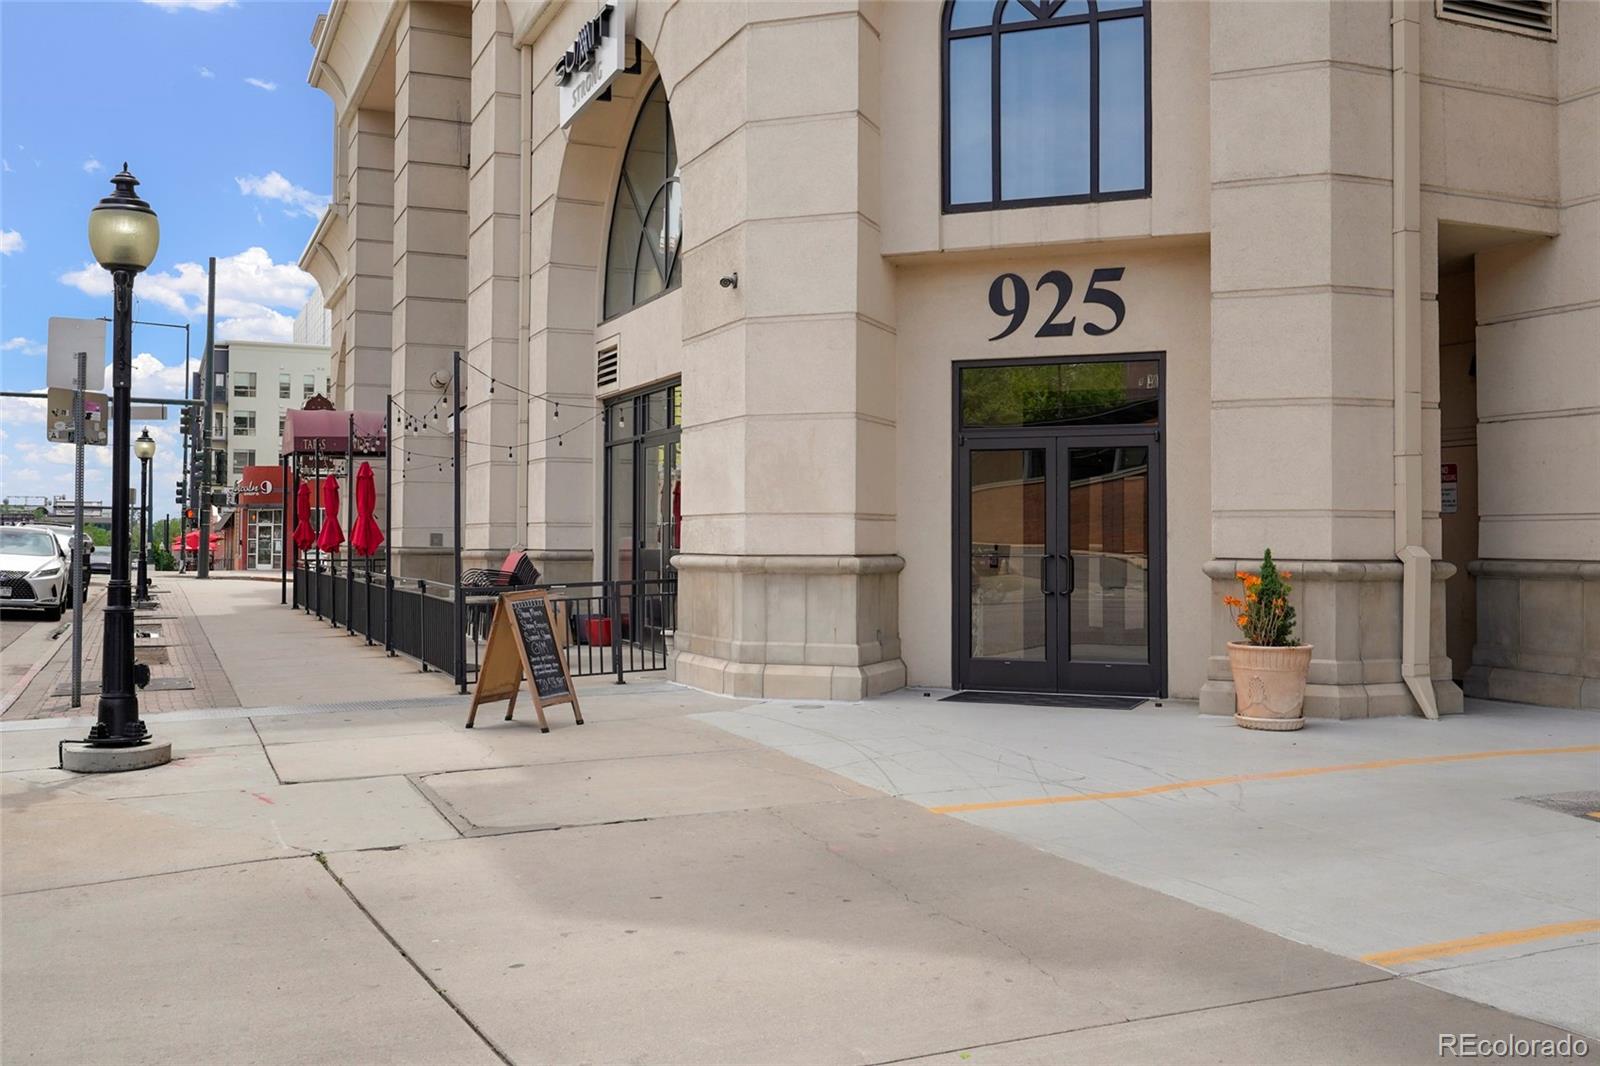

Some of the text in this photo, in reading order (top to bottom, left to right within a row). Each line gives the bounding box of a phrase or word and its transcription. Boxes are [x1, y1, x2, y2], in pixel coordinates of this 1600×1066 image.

[572, 60, 603, 108] STRONG
[988, 267, 1126, 341] 925
[303, 439, 326, 450] TAS
